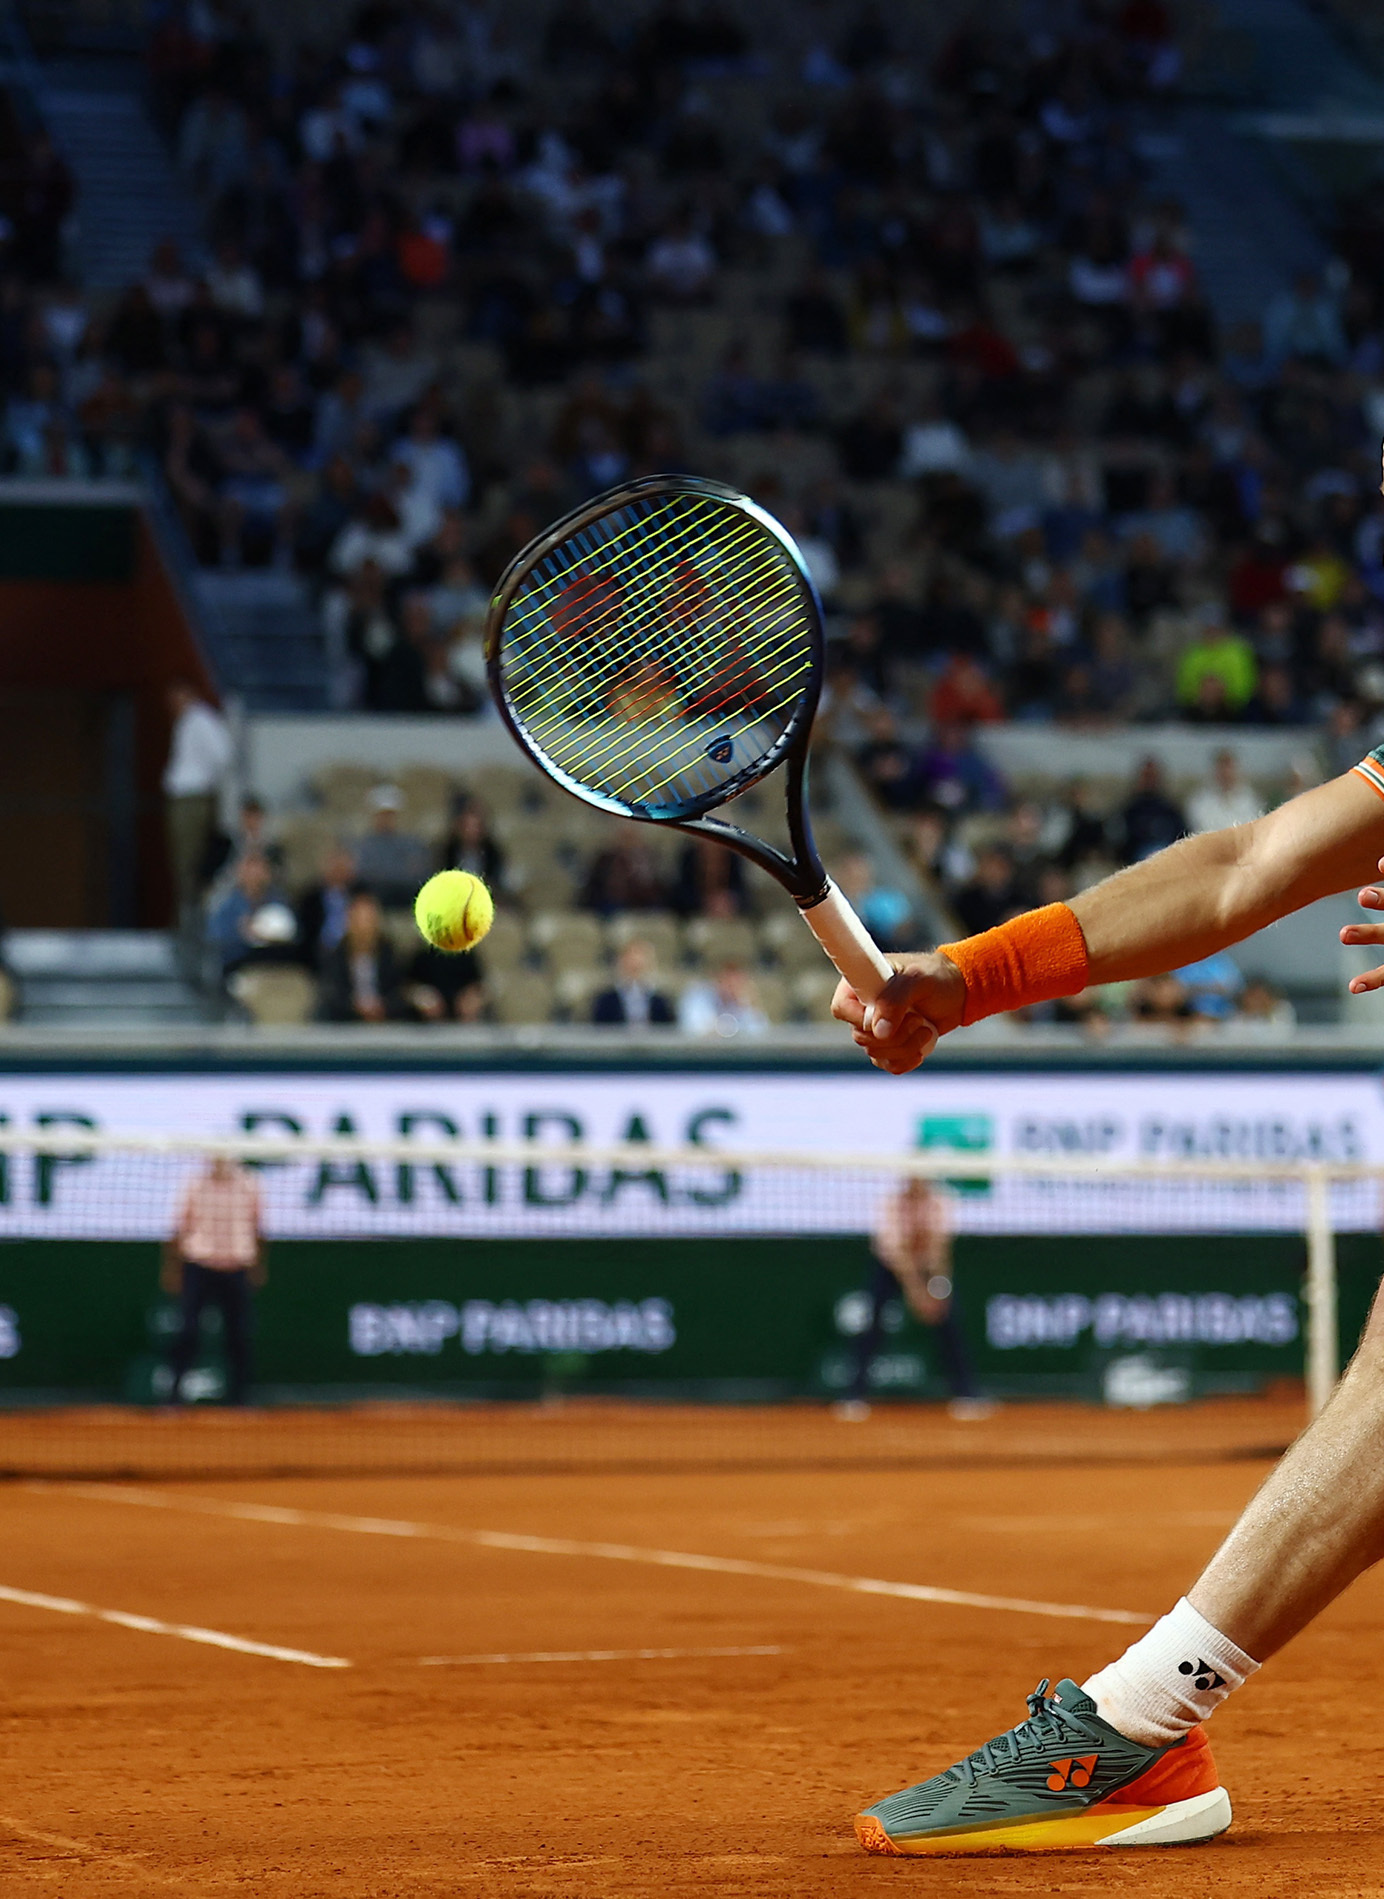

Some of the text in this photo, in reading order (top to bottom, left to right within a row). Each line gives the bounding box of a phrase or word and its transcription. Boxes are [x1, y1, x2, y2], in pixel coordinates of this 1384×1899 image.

[241, 1108, 740, 1209] PARIBAS
[1016, 1113, 1363, 1160] BNP PARIBAS
[349, 1299, 676, 1355] BNP PARIBAS
[1094, 1291, 1298, 1347] PARIBAS
